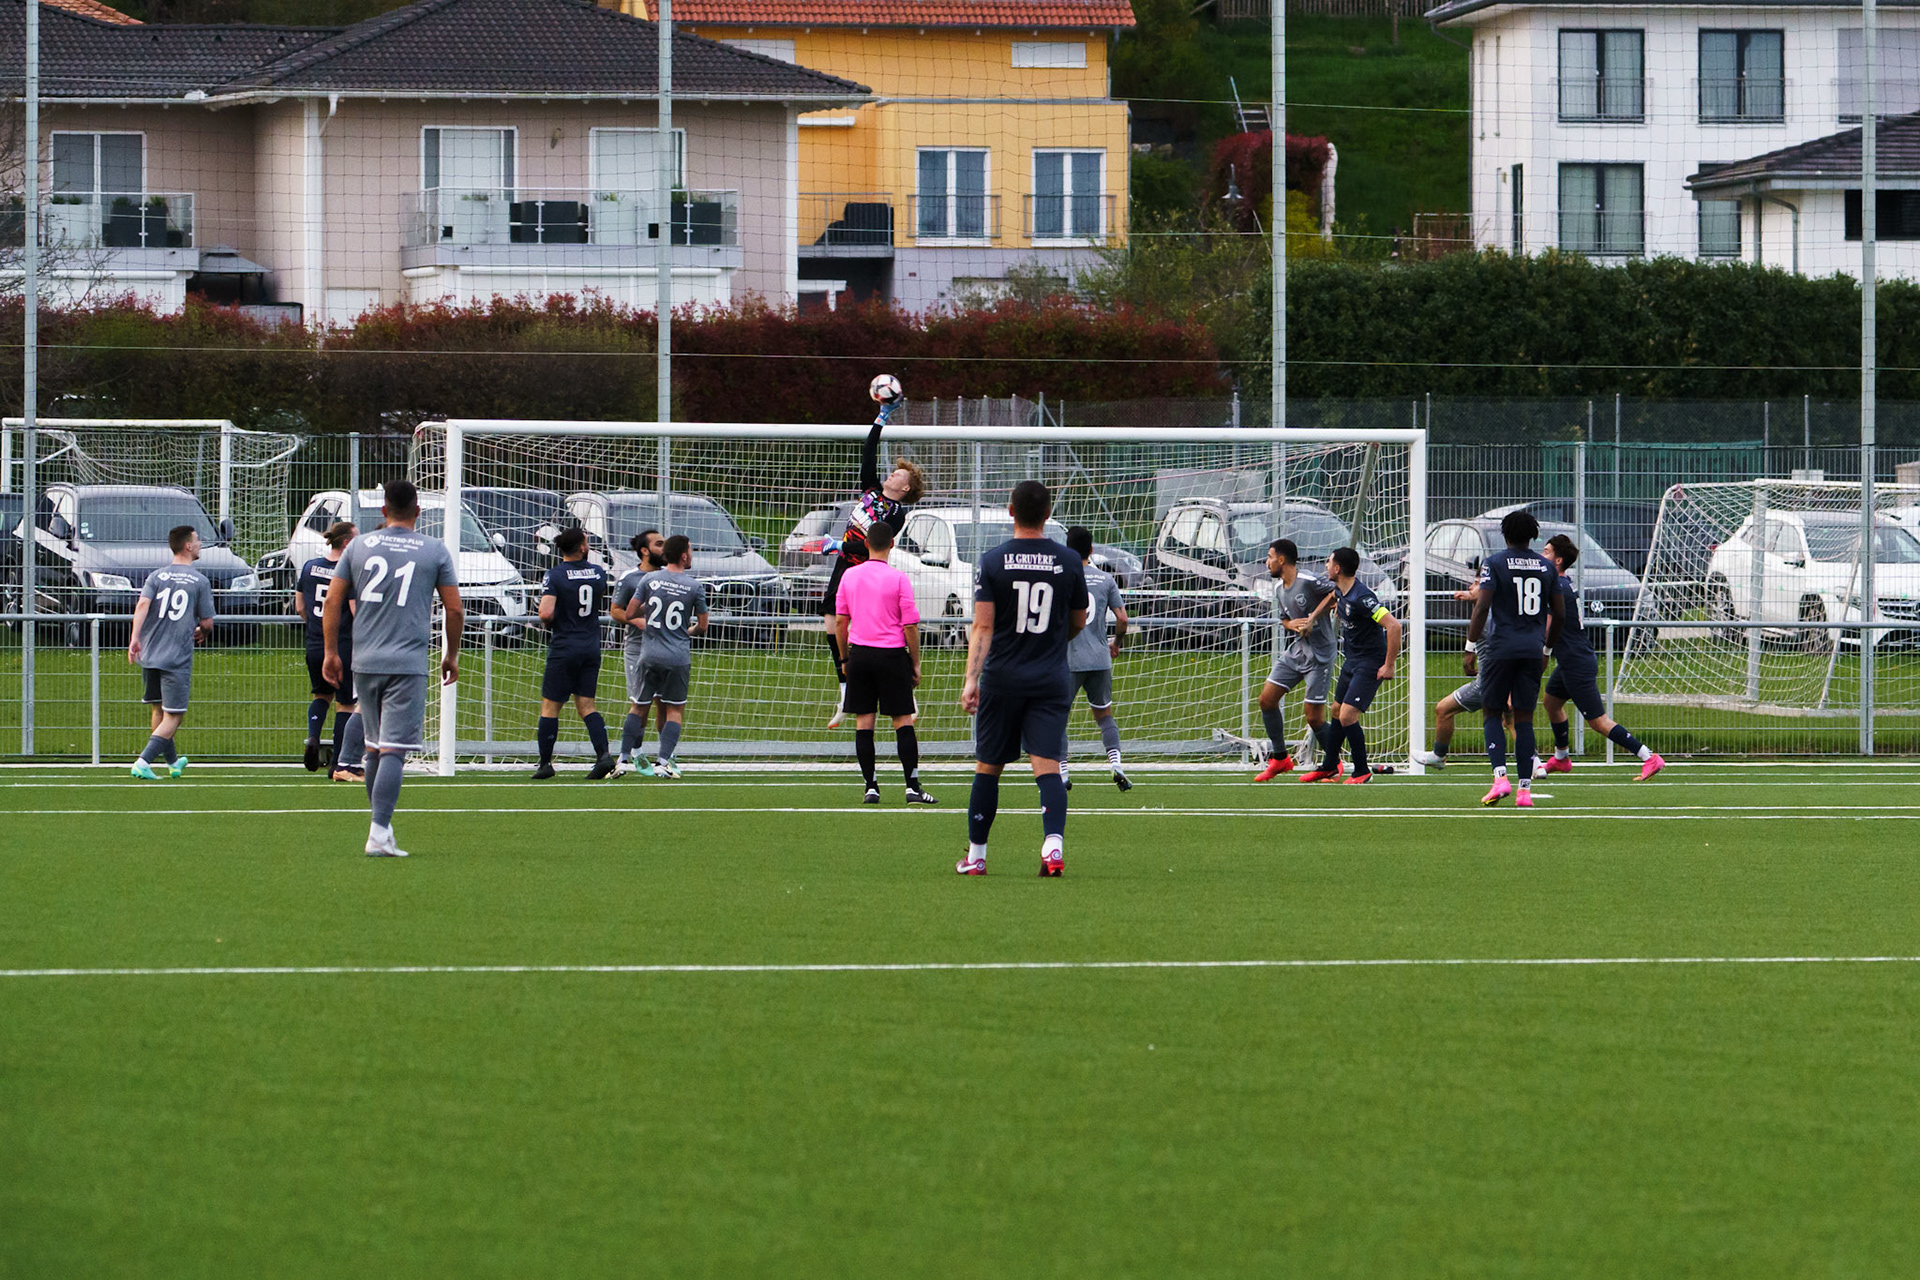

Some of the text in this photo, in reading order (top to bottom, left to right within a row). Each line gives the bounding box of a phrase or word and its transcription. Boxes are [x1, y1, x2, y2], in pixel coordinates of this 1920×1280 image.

[378, 534, 424, 547] ELECTRO-PLUS
[1004, 552, 1054, 565] LE GRUYÈRE
[360, 555, 416, 607] 21
[1512, 577, 1542, 616] 18
[156, 587, 189, 621] 19
[313, 583, 330, 618] 5
[578, 584, 593, 617] 9
[647, 596, 685, 631] 26
[1012, 581, 1054, 634] 19
